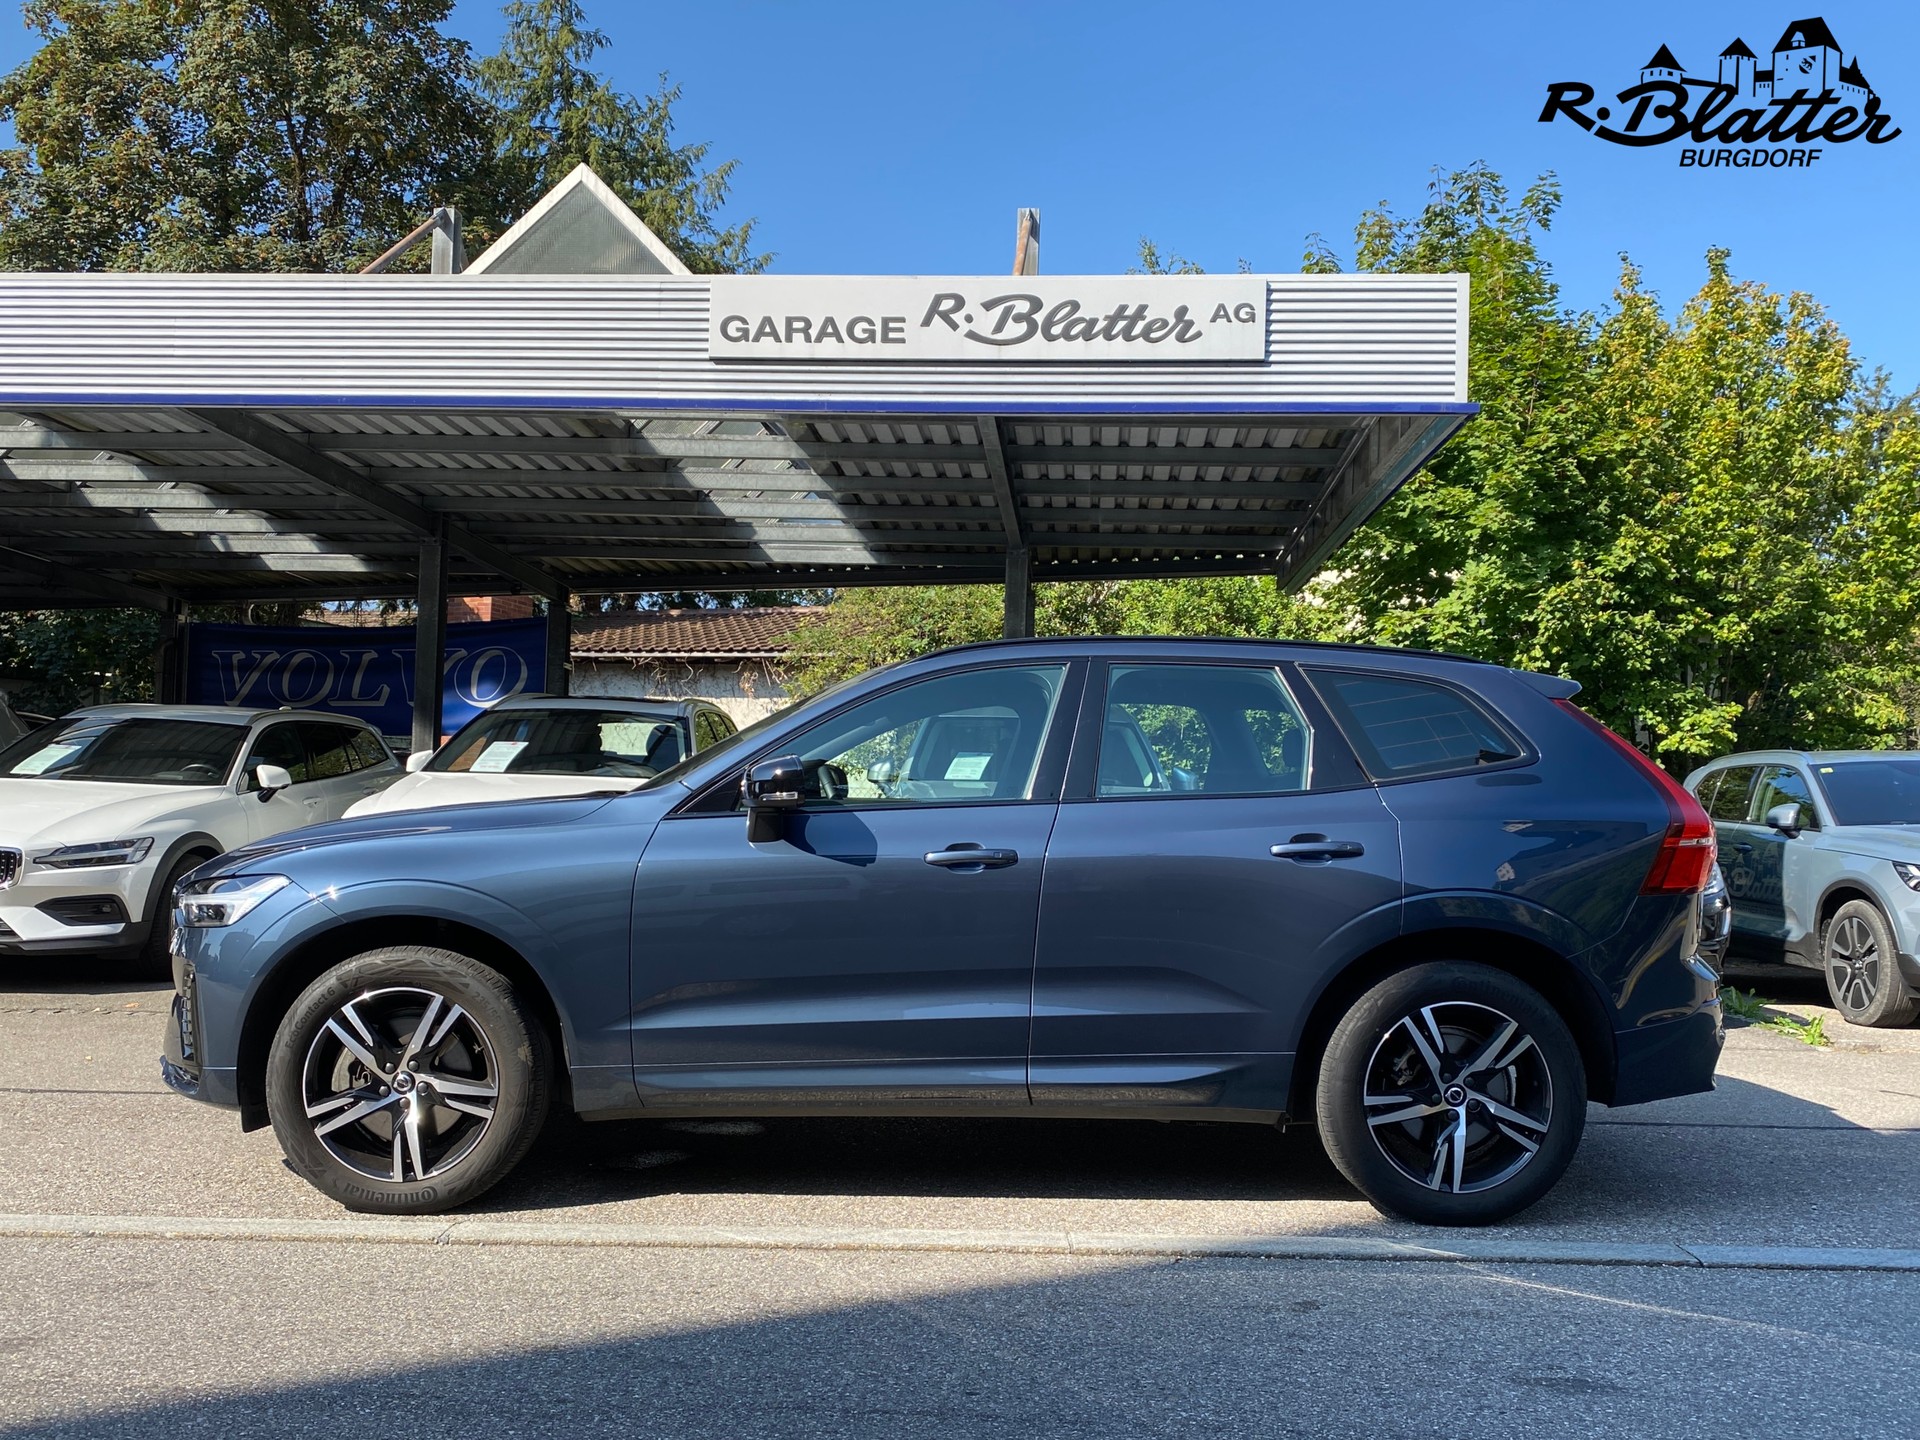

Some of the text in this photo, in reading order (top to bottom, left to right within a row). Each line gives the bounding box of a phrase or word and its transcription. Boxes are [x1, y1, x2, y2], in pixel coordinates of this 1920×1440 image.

[719, 314, 906, 344] GARAGE
[1210, 302, 1256, 324] AG
[284, 986, 336, 1049] EcoContact 6
[343, 1182, 438, 1204] Continental
